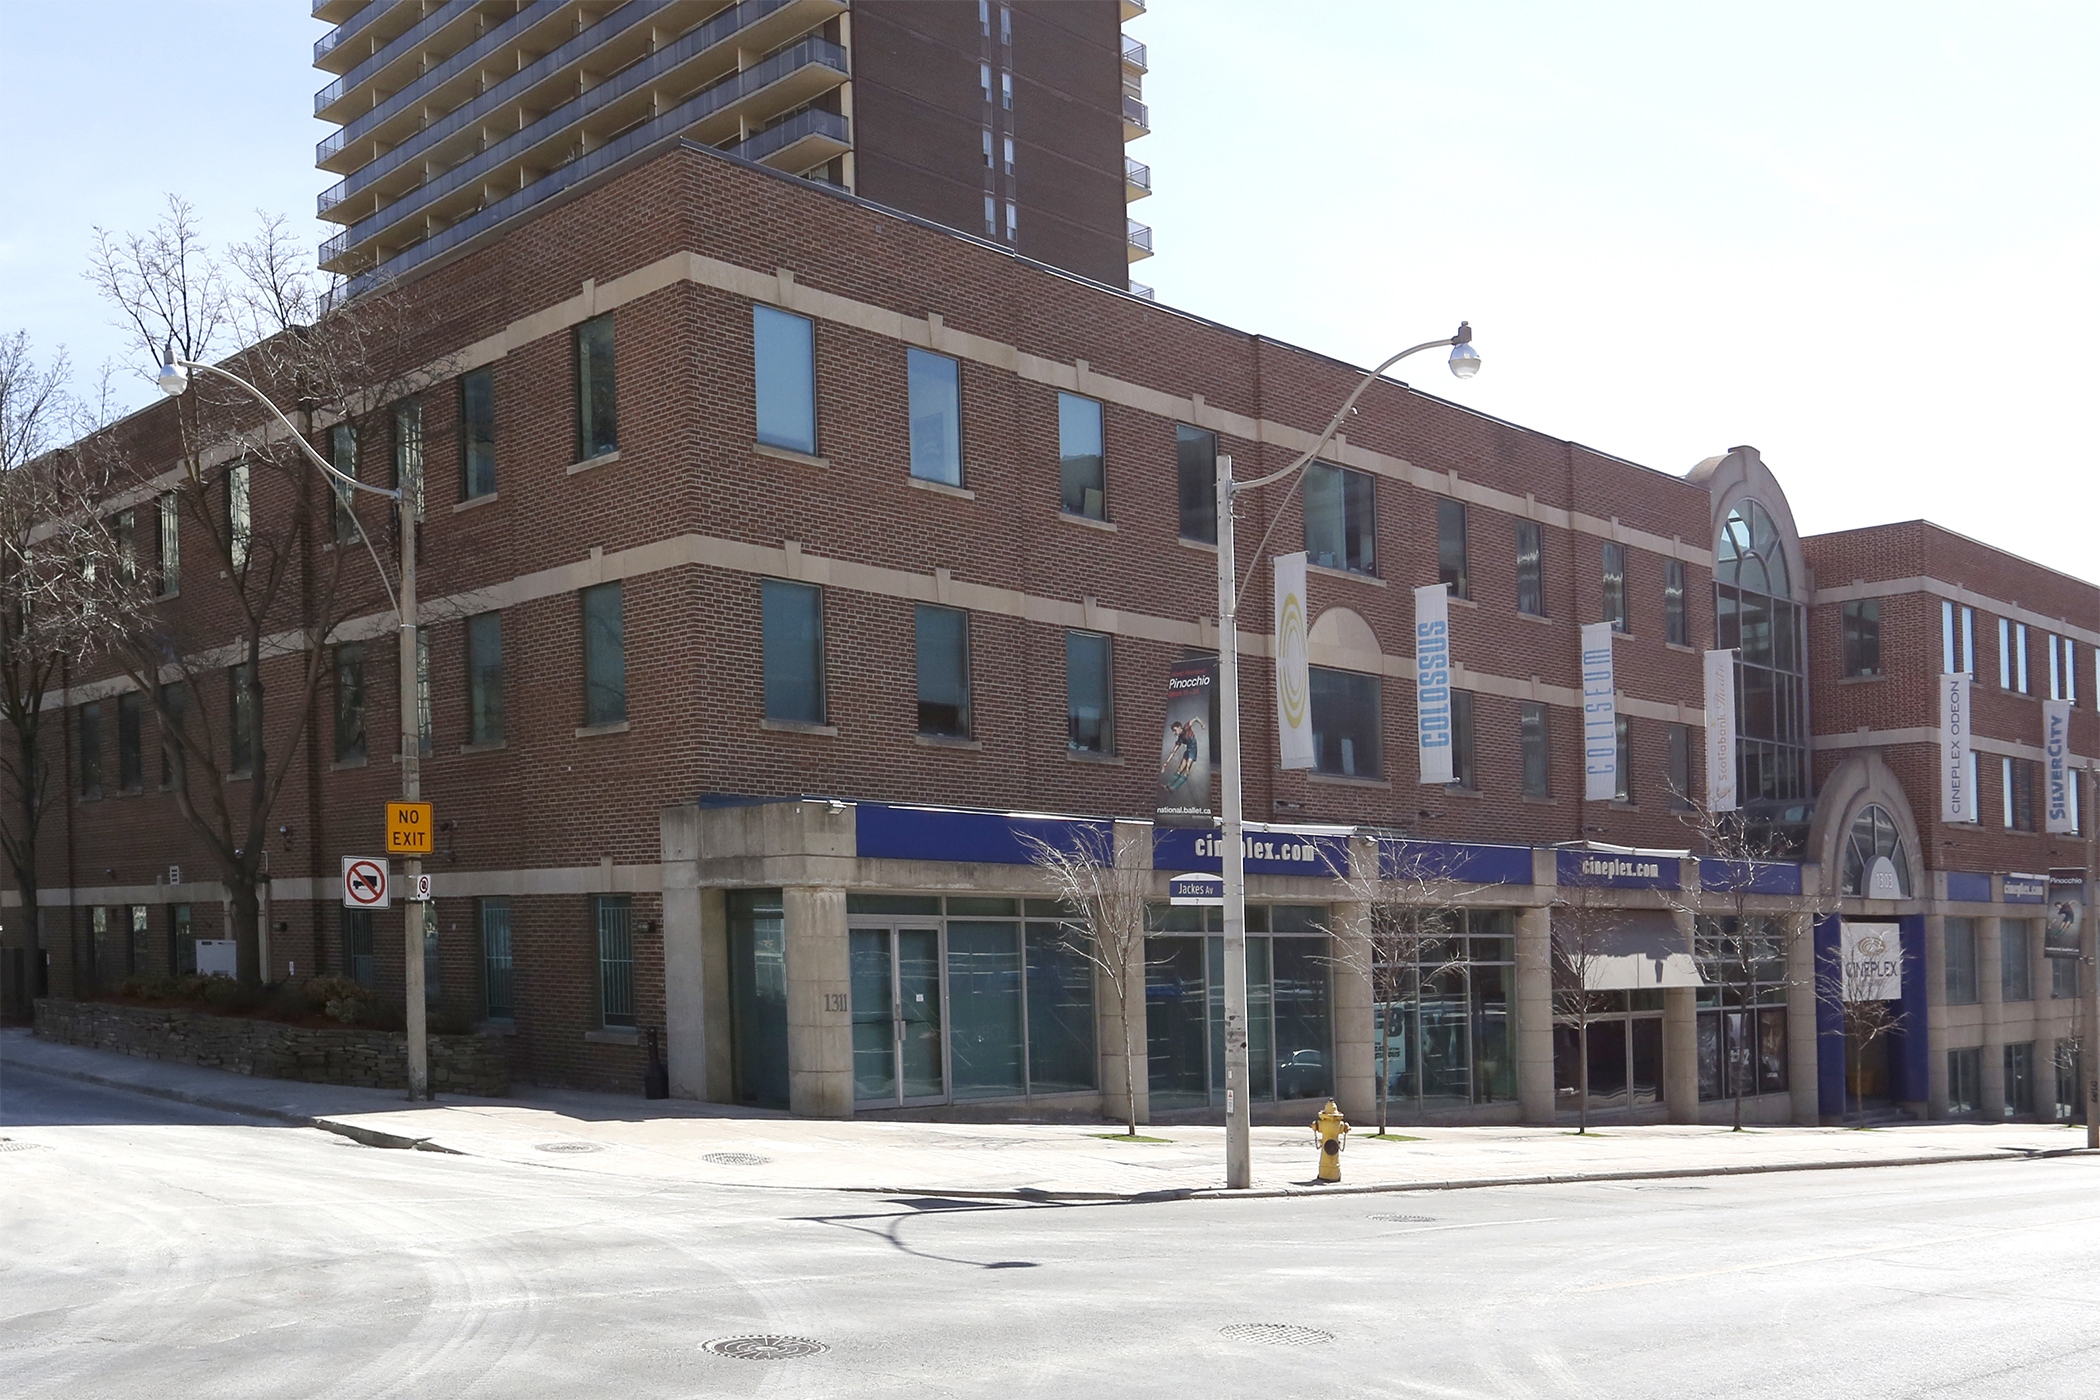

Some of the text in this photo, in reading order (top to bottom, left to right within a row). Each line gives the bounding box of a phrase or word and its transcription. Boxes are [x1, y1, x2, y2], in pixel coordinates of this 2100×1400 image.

[1168, 674, 1211, 690] Pinocchio
[1417, 620, 1450, 748] COLOSSUS
[1583, 648, 1615, 775] COLISEUM
[1717, 713, 1727, 781] Scotiabank
[1950, 681, 1961, 814] CINEPLEX ODEON
[399, 810, 419, 824] NO
[1156, 806, 1212, 814] national.ballet.ca
[393, 832, 426, 846] EXIT
[1195, 833, 1315, 862] cinlex.com
[1582, 856, 1659, 879] cineplex.com
[1178, 883, 1214, 895] Jackes Av
[1845, 961, 1898, 977] CINEPLEX
[824, 993, 848, 1012] 1311
